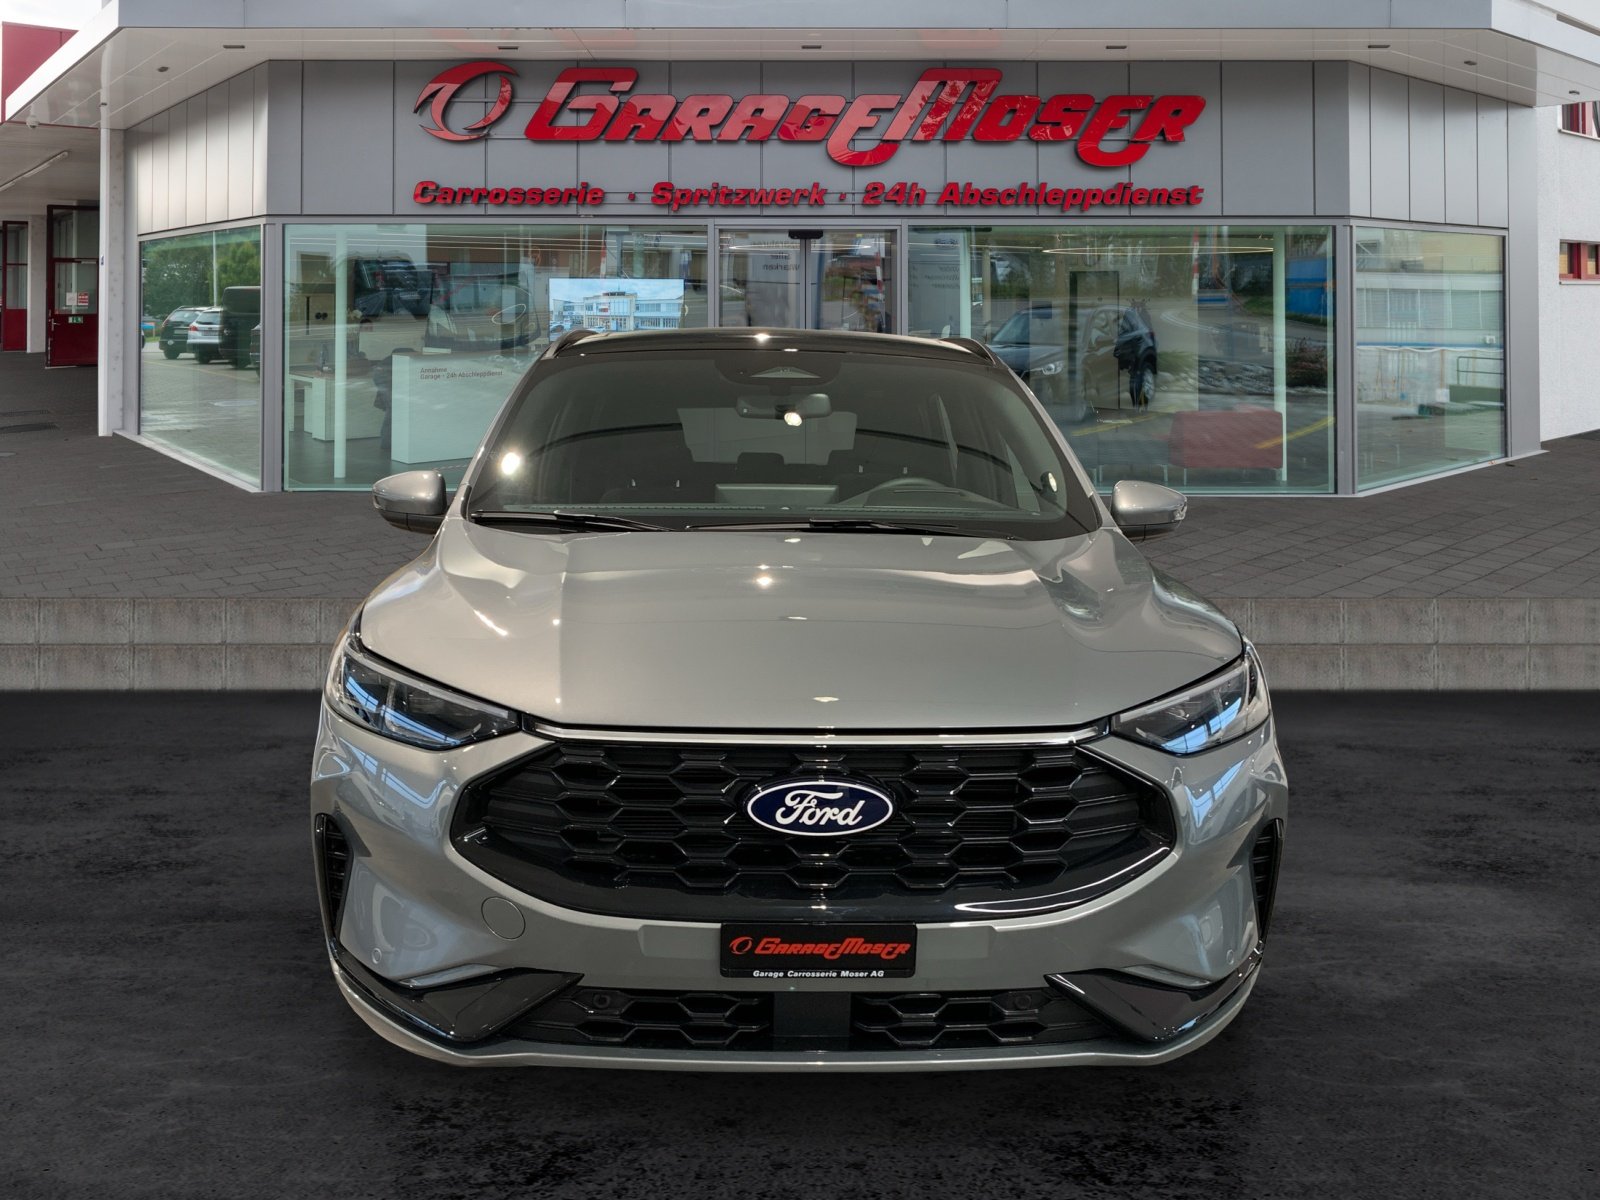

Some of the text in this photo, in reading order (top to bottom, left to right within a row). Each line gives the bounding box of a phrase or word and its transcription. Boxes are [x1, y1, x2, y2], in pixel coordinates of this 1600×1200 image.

[413, 180, 605, 206] Carrosserie
[651, 181, 827, 211] Spritzwerk
[862, 181, 927, 206] 24h
[937, 181, 1204, 211] Abschleppdienst
[420, 373, 441, 381] Garage
[458, 370, 503, 379] Abschleppdienst
[775, 789, 866, 826] Ford
[752, 970, 885, 979] Garage Carrosserie Moser AG
